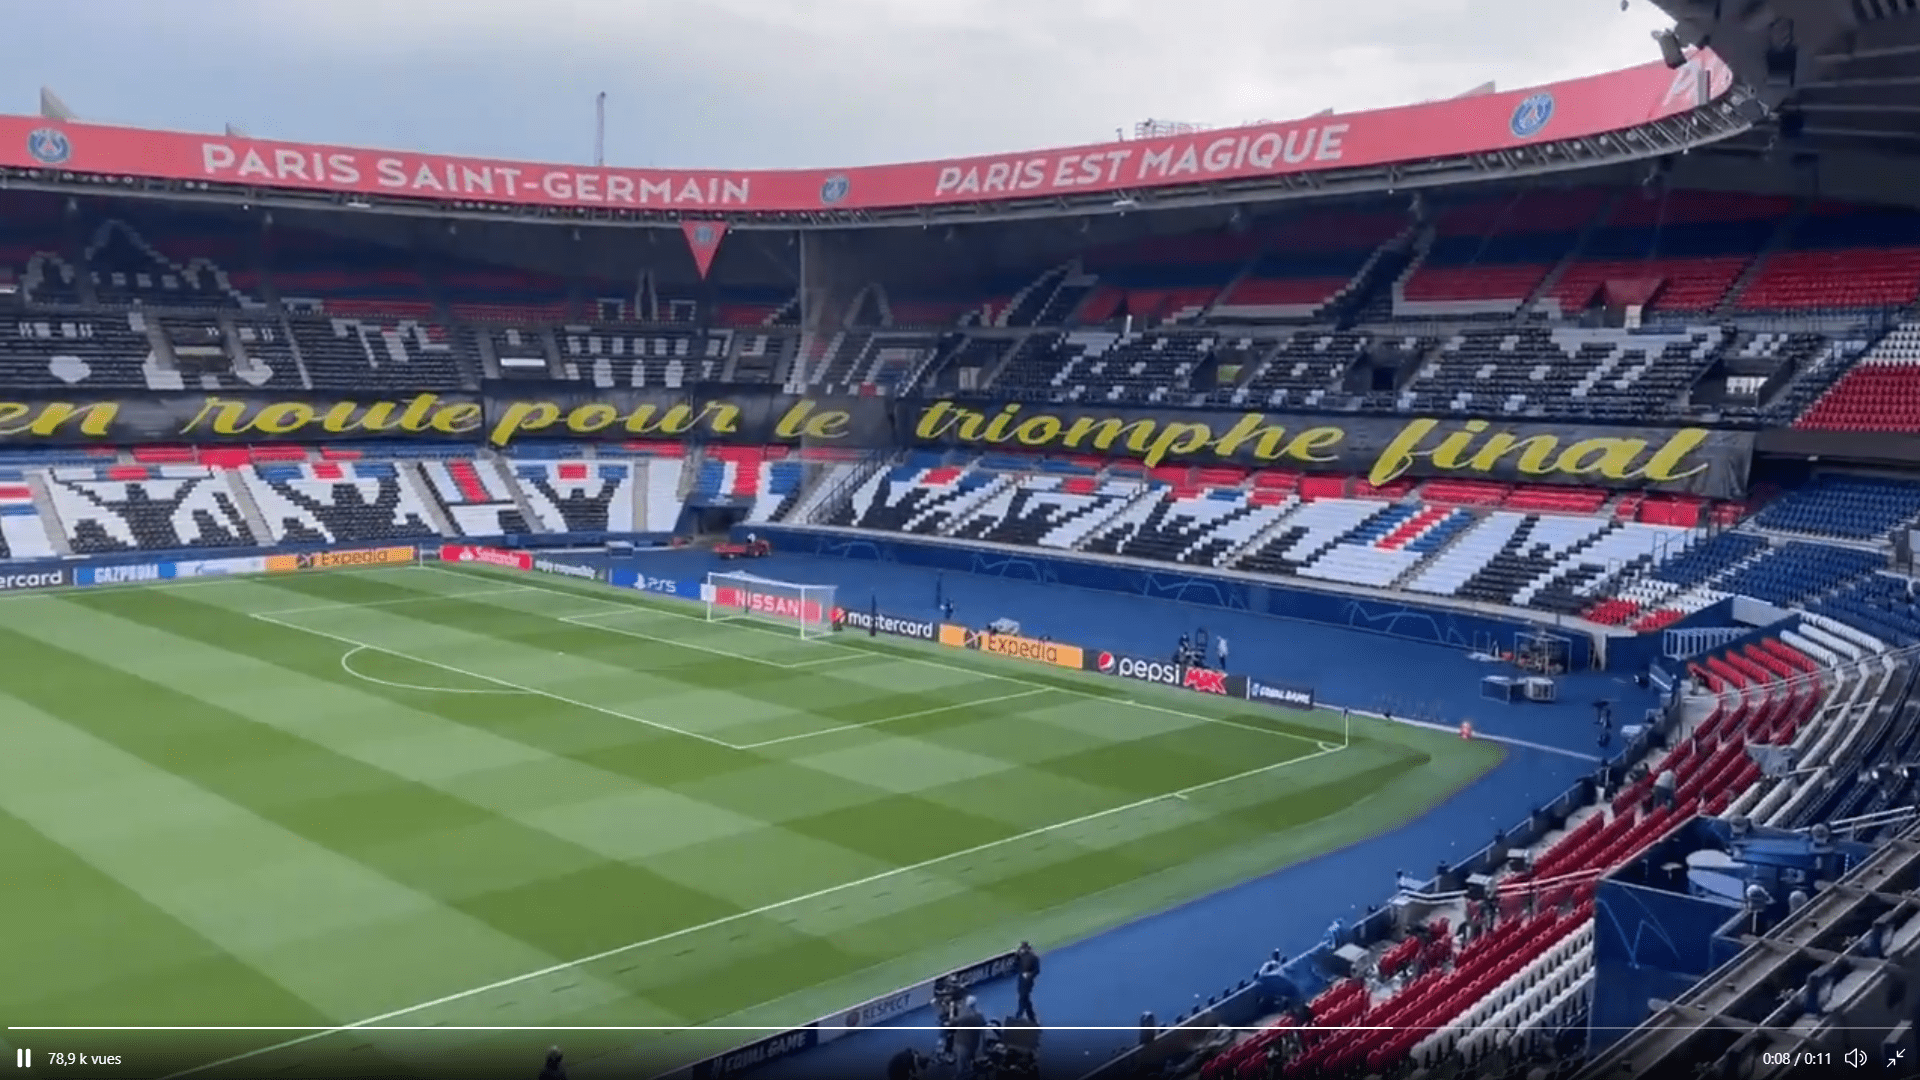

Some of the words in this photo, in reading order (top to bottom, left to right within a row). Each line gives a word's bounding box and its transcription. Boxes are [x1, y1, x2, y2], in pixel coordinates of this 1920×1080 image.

[935, 158, 1046, 196] PARIS
[1052, 149, 1131, 187] EST
[1137, 123, 1350, 180] MAGIQUE
[202, 142, 360, 183] PARIS
[376, 157, 749, 204] SAINT-GERMAIN
[0, 402, 119, 435] en
[179, 393, 482, 434] route
[491, 401, 738, 446] pour
[775, 401, 850, 438] le
[915, 401, 1346, 468] triomphe
[1369, 418, 1710, 487] final
[321, 548, 388, 566] Expedia
[94, 564, 158, 583] GAZPROM
[647, 577, 676, 593] PS5
[735, 588, 799, 616] NISSAN
[988, 633, 1058, 662] Expedia
[1119, 658, 1180, 684] pepsi
[862, 994, 911, 1020] RESPECT
[767, 1032, 807, 1058] GAME
